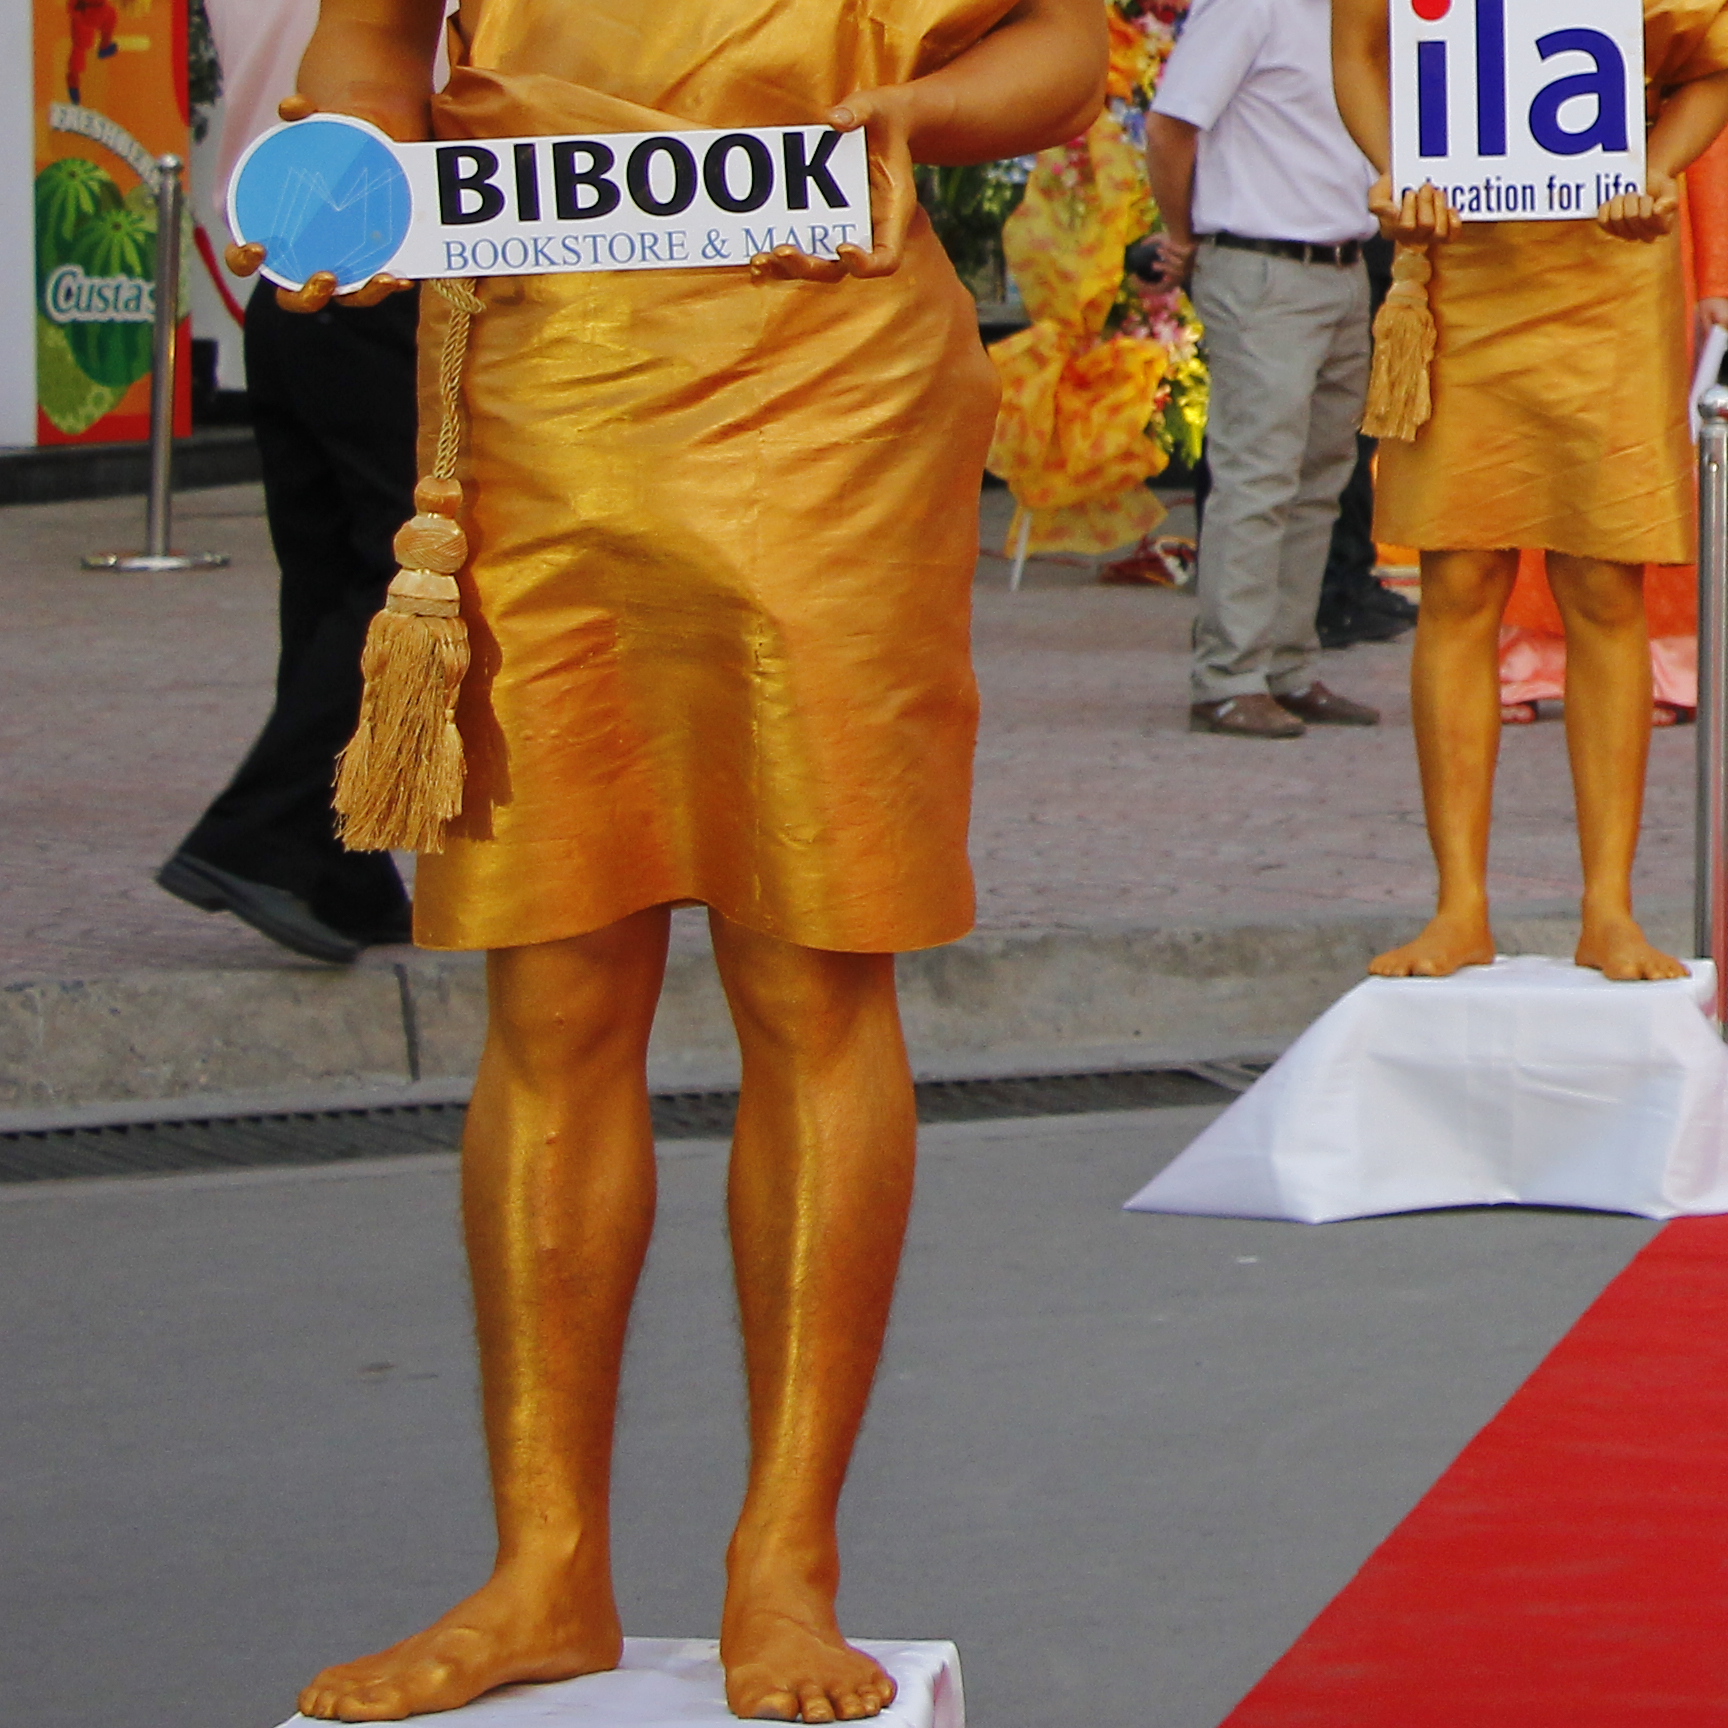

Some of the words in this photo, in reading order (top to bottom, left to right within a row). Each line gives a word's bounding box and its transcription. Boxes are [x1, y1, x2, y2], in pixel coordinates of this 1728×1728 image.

[435, 129, 851, 226] BIBOOK
[1548, 174, 1585, 212] for
[443, 228, 690, 271] BOOKSTORE
[701, 226, 731, 259] &
[742, 224, 857, 257] MART
